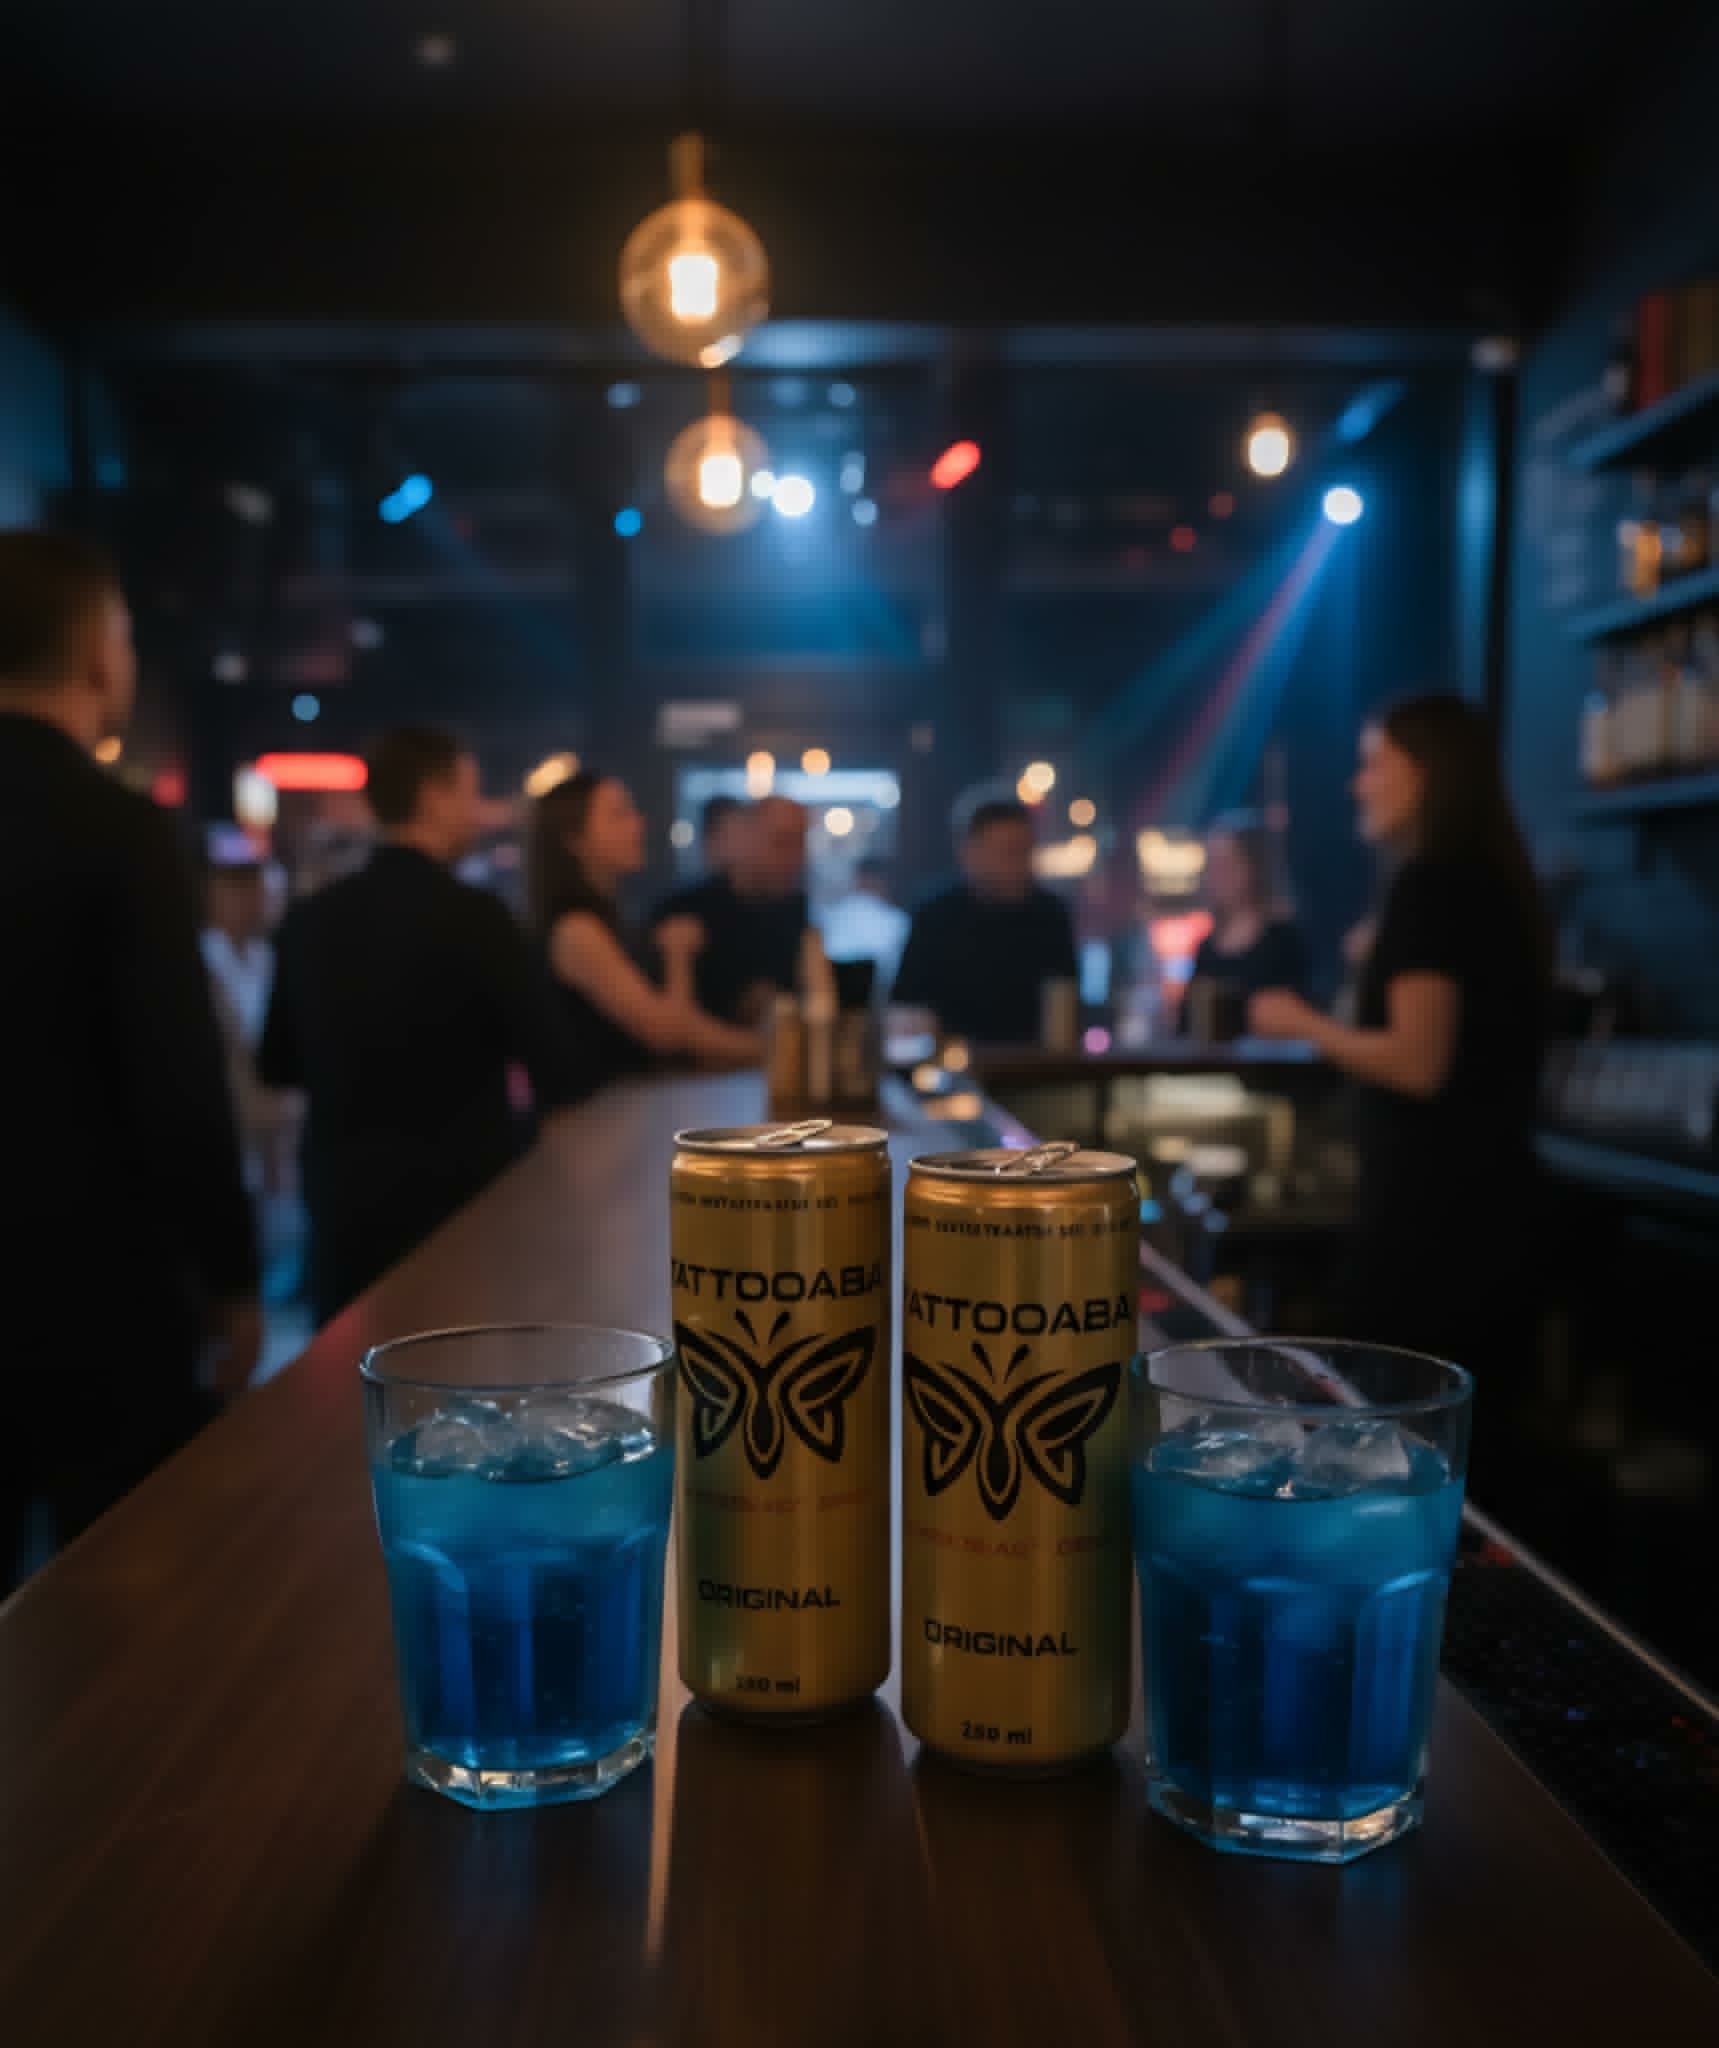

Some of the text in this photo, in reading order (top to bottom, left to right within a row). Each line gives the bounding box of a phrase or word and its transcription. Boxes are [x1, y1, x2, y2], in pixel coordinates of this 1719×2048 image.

[698, 1578, 841, 1611] ORIGINAL
[924, 1617, 1080, 1656] ORIGINAL
[775, 1674, 800, 1693] ml
[960, 1720, 1033, 1745] 250 ml
